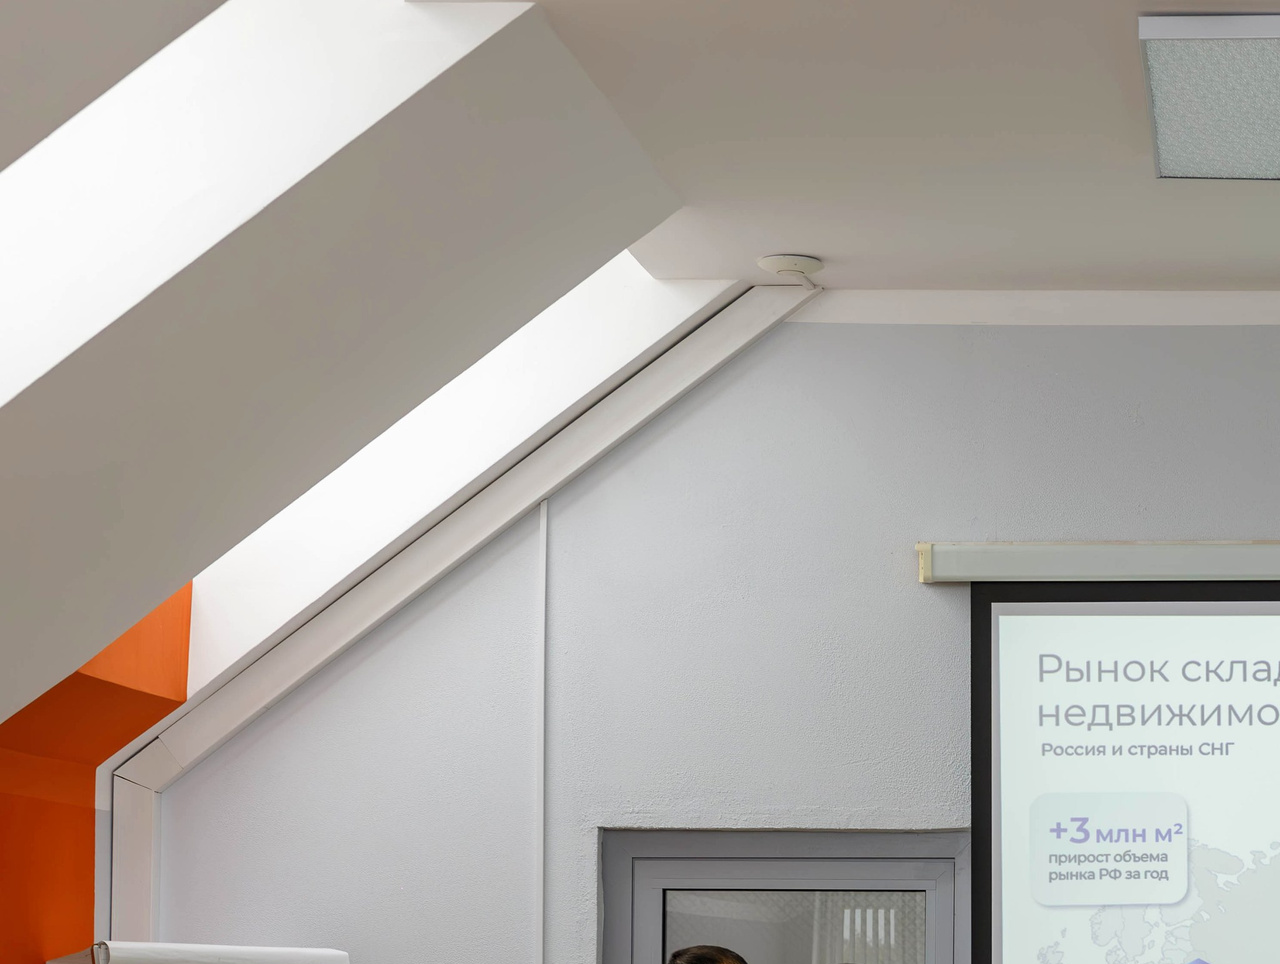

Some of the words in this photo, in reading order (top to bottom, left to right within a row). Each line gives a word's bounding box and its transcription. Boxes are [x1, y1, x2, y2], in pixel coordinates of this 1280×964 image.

[1038, 653, 1170, 683] Рынок
[1041, 742, 1107, 757] Россия
[1112, 745, 1123, 757] и
[1128, 745, 1194, 759] страны
[1198, 742, 1235, 757] СНГ
[1049, 816, 1091, 845] +3
[1095, 827, 1147, 844] млн
[1048, 851, 1111, 867] прирост
[1113, 850, 1169, 864] объема
[1048, 869, 1096, 884] рынка
[1099, 867, 1122, 882] РФ
[1125, 869, 1141, 881] за
[1144, 869, 1170, 883] год
